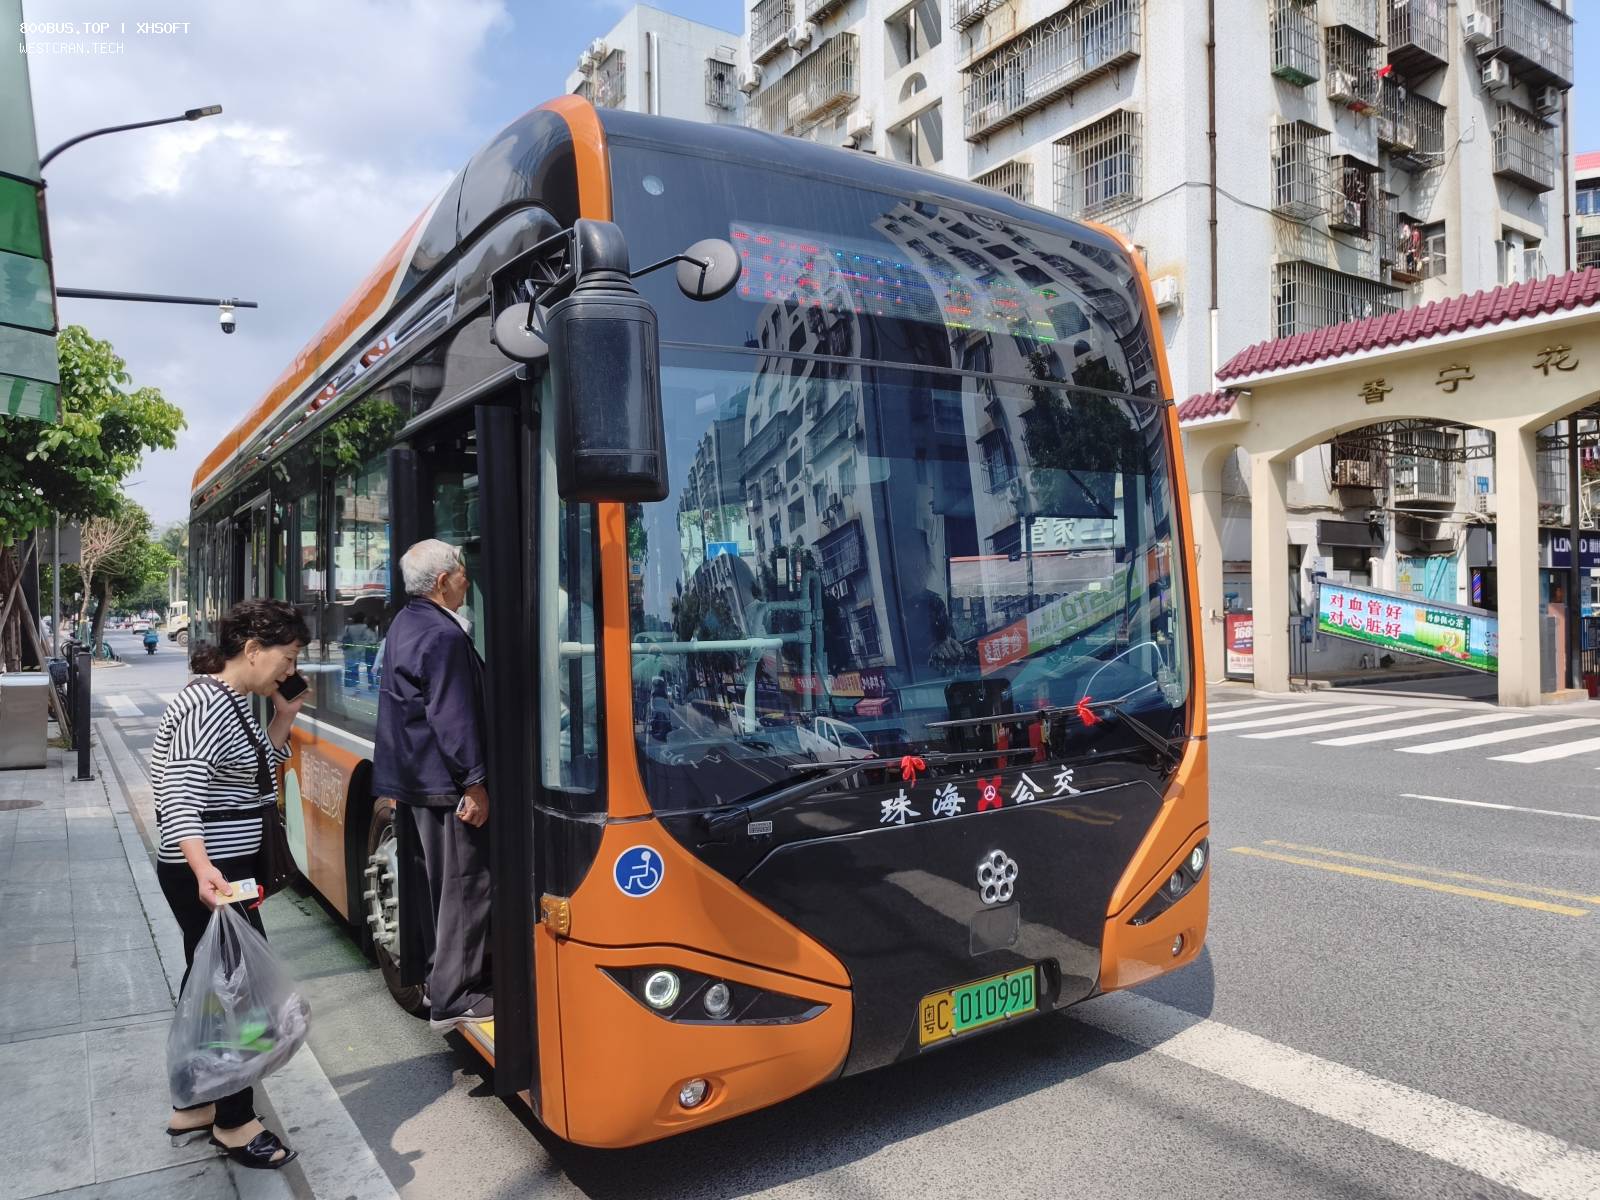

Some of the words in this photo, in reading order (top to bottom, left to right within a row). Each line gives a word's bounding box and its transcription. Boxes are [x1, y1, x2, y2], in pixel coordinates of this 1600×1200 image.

[1329, 593, 1402, 620] 对血管好
[1328, 610, 1402, 639] 对心脏好
[879, 782, 967, 825] 珠海
[1010, 764, 1081, 804] 公交
